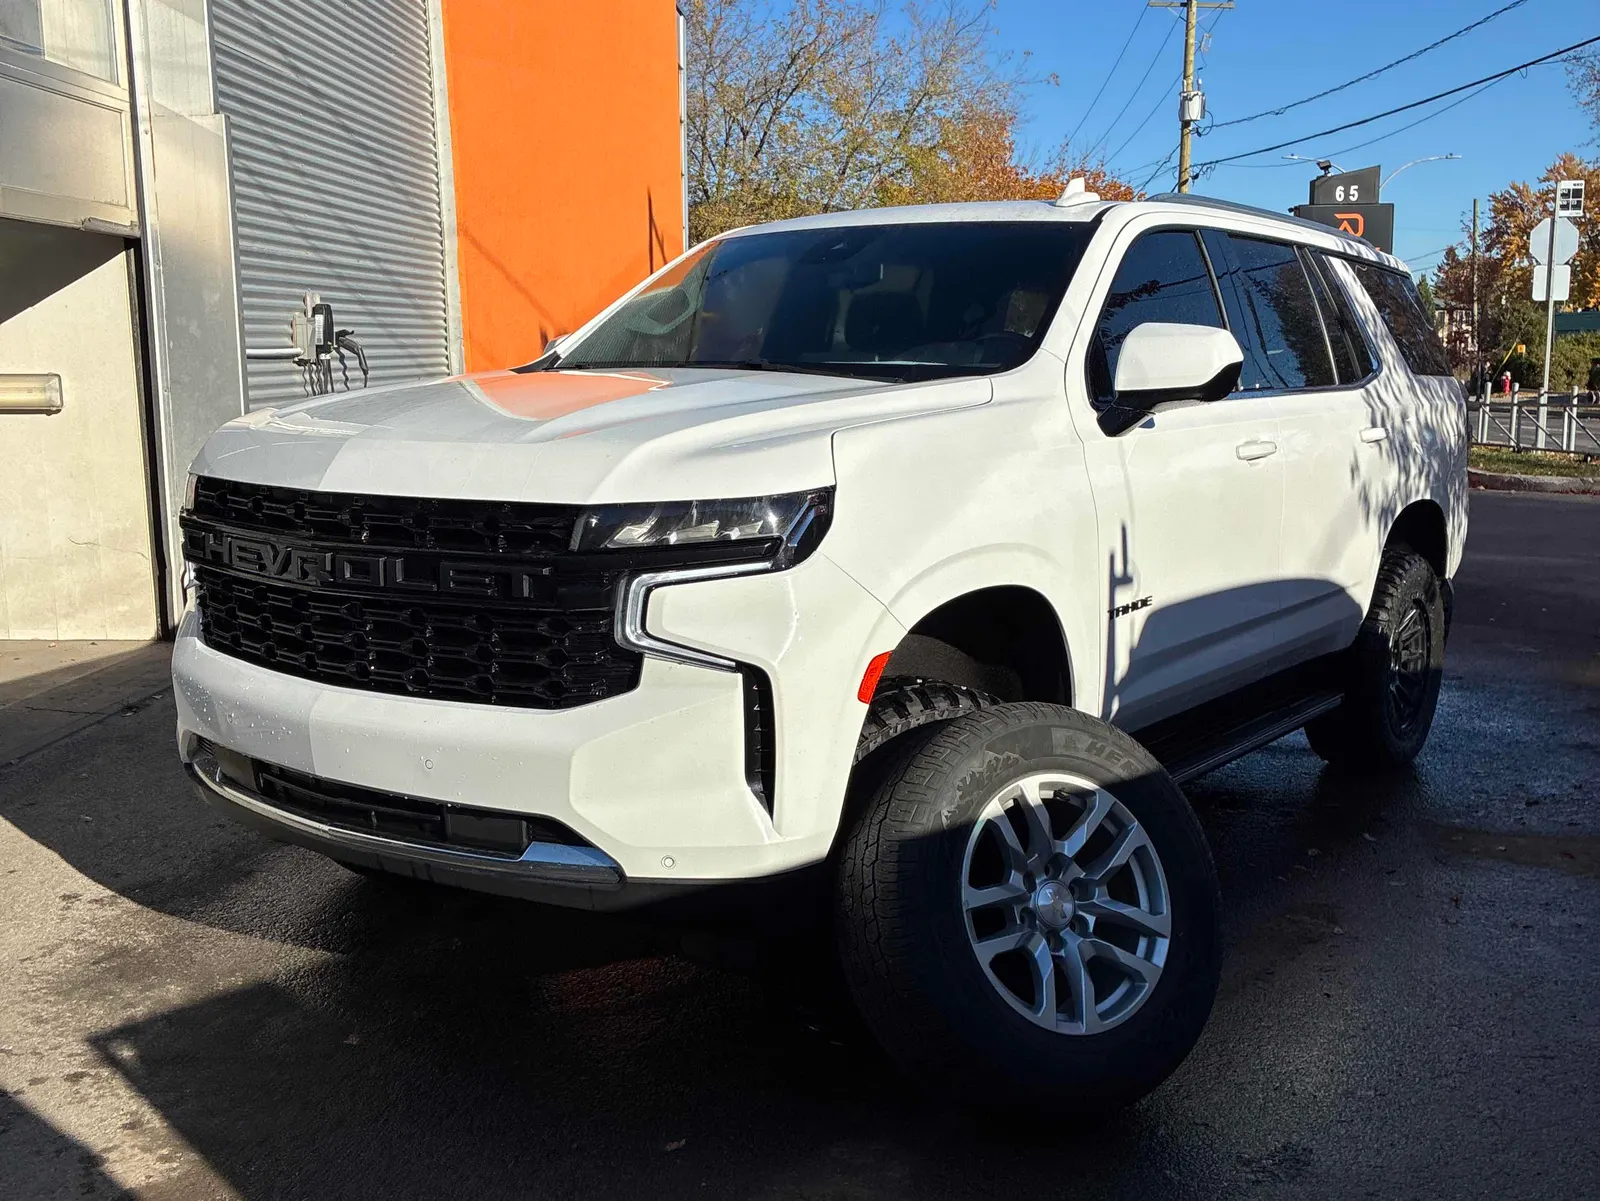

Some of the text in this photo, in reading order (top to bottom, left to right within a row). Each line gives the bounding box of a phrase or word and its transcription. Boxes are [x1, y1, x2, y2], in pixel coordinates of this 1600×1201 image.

[183, 527, 553, 599] CHEVROLET
[1107, 595, 1153, 620] TAHOE
[1084, 740, 1142, 778] HER
